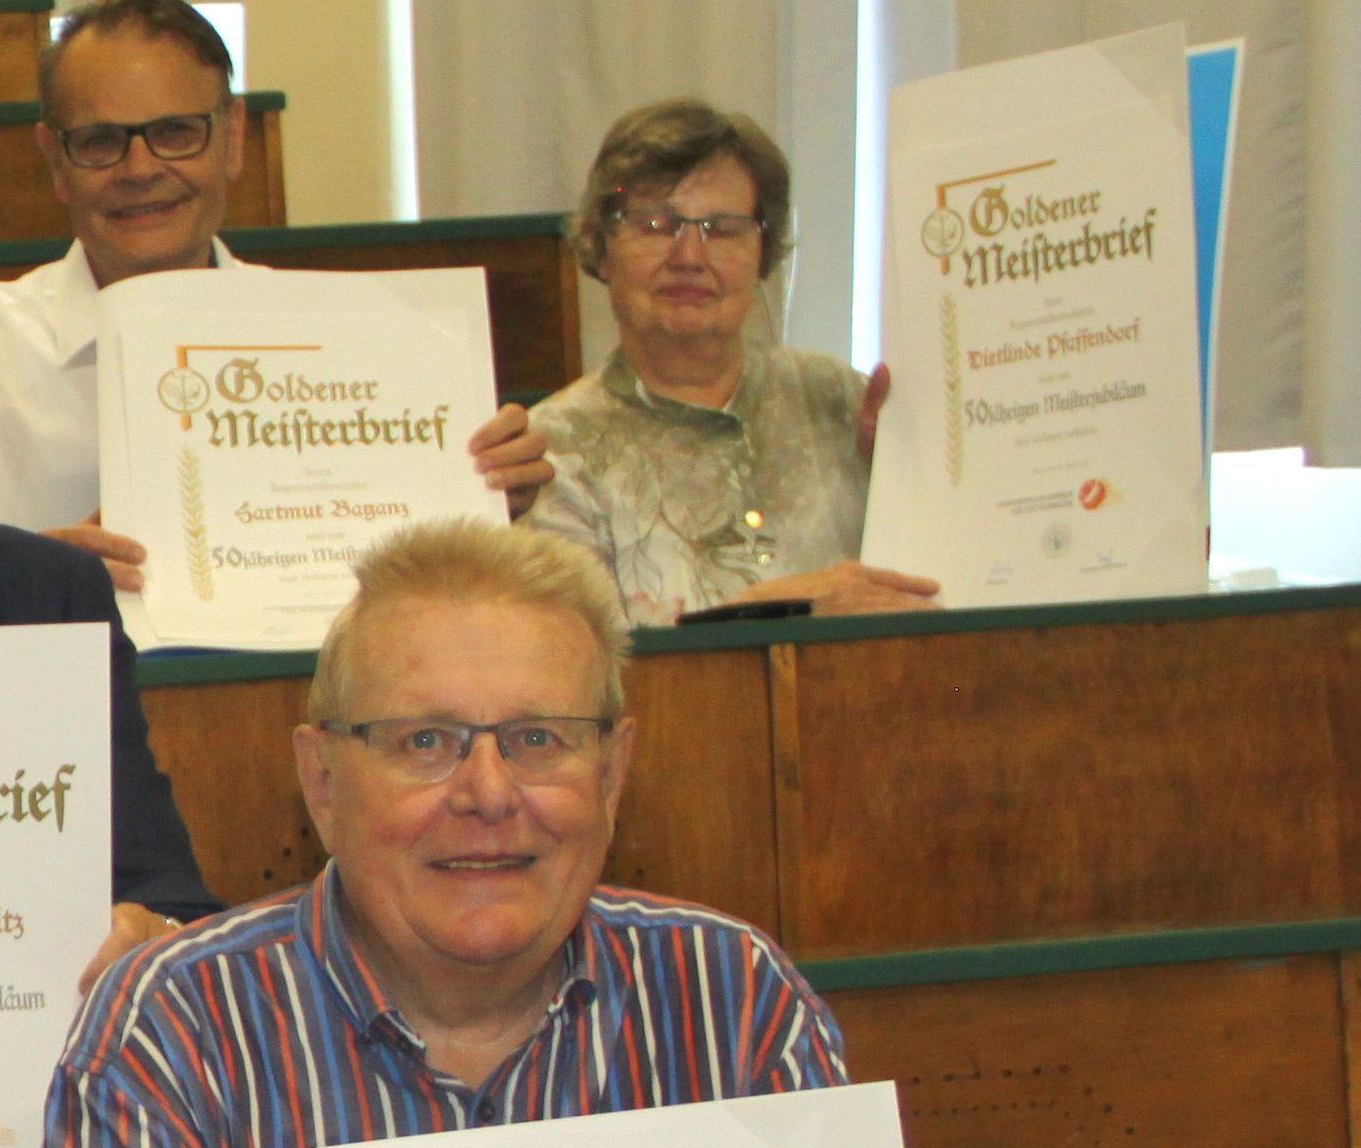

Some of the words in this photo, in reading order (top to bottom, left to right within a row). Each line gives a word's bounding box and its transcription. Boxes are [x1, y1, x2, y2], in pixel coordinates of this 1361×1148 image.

[969, 184, 1101, 240] Goldener
[215, 357, 378, 402] Goldener
[234, 501, 324, 524] Hartmut
[211, 545, 307, 569] 50jährigen
